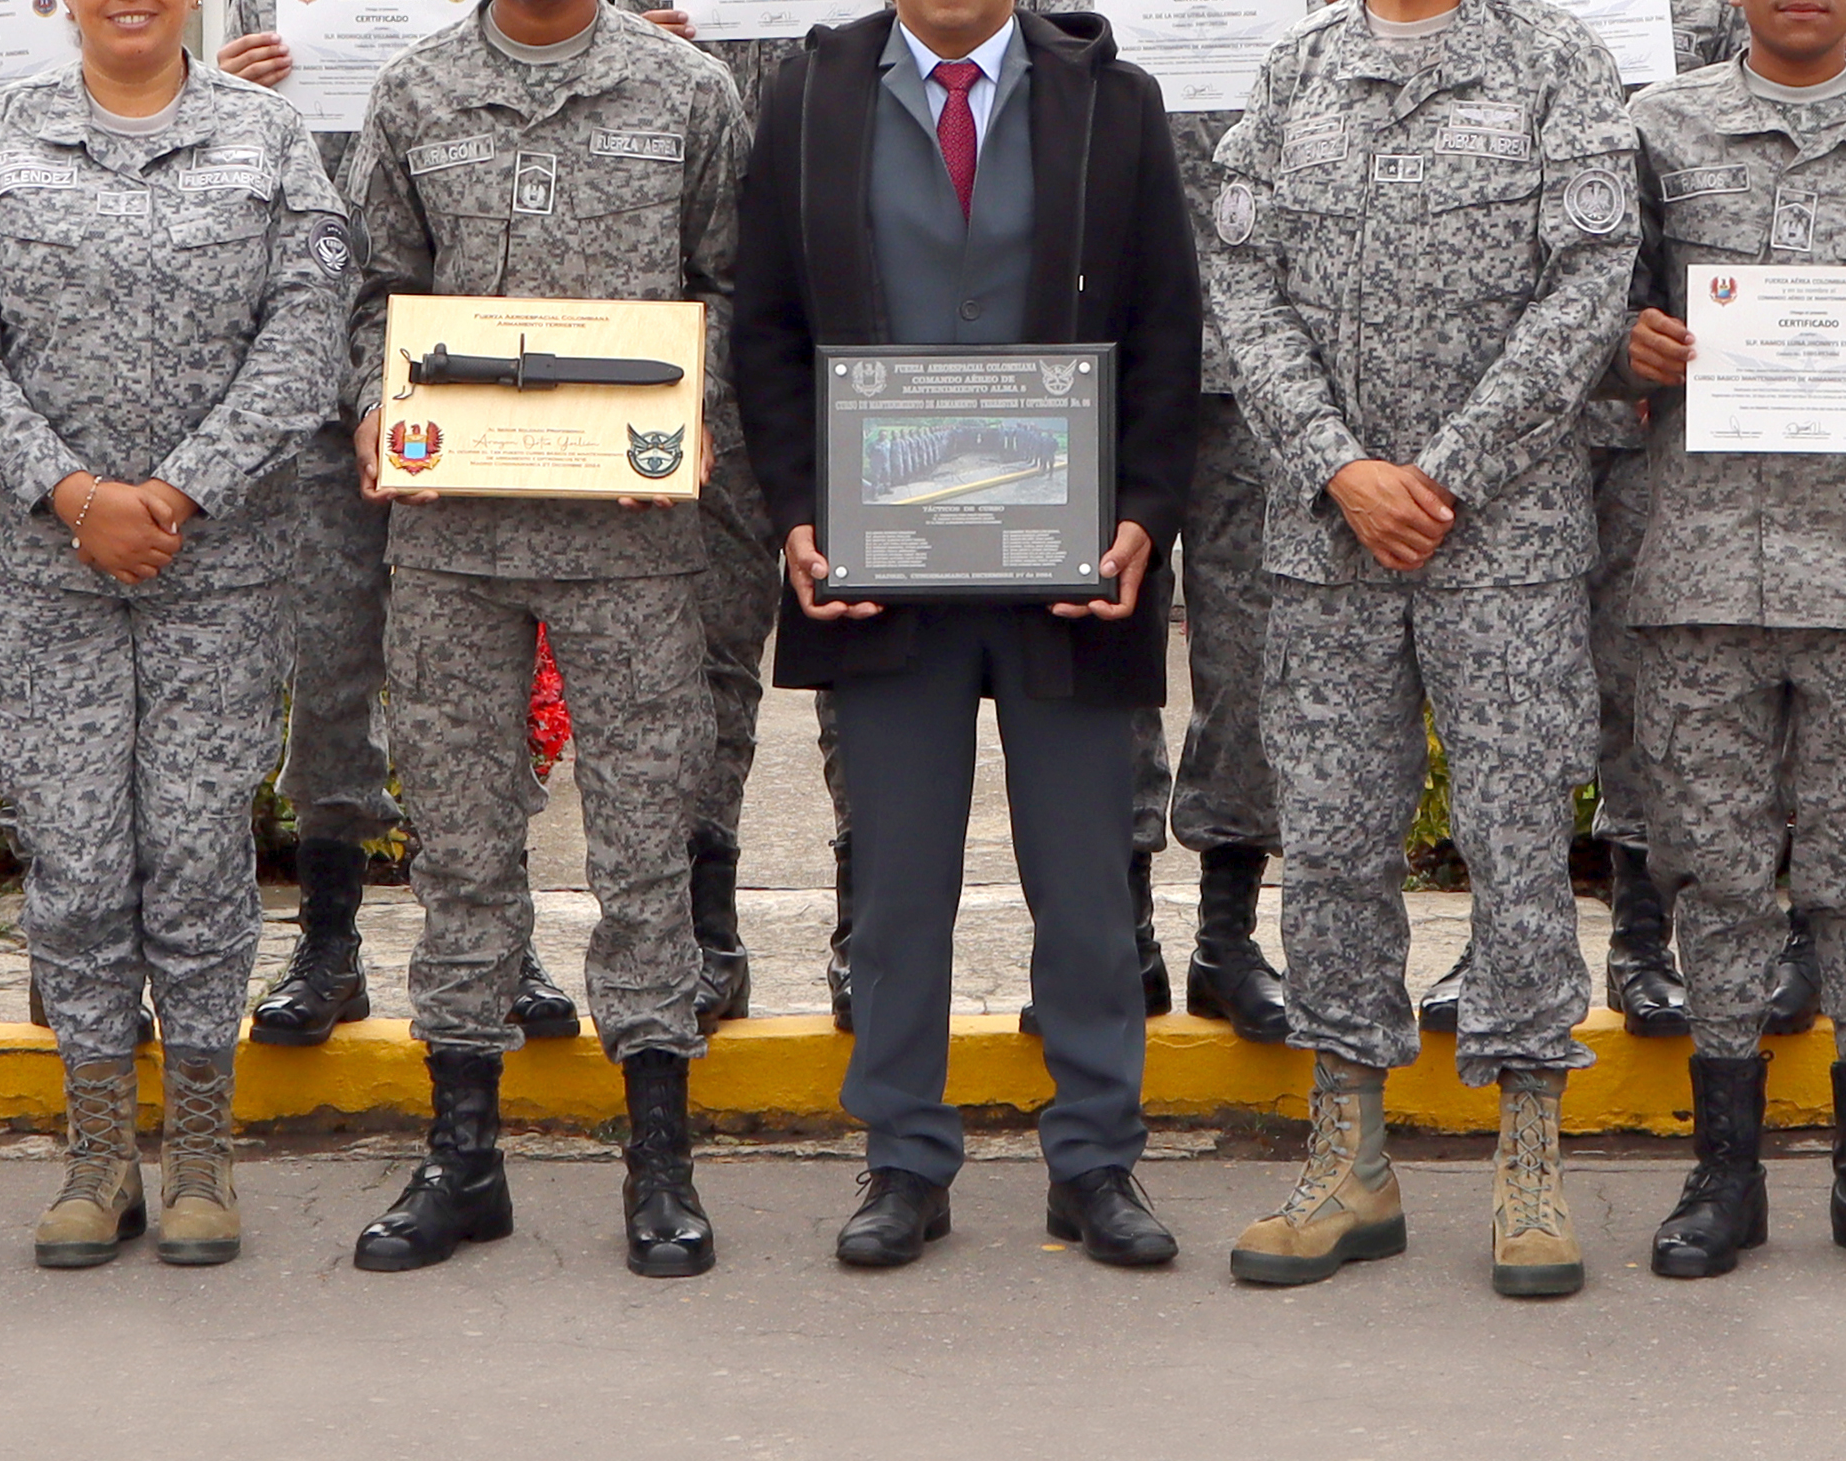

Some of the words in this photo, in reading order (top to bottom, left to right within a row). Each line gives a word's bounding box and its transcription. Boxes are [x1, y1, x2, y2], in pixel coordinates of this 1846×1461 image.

[355, 15, 409, 23] CERTIFICADO
[597, 136, 638, 152] FUERZA
[644, 138, 677, 156] AEREA
[1444, 135, 1486, 150] FUERZA
[1489, 138, 1525, 154] AEREA
[185, 171, 232, 186] FUERZA
[1682, 174, 1725, 189] RAMOS
[1790, 277, 1811, 285] AÉREA
[1778, 319, 1839, 328] CERTIFICADO
[912, 376, 961, 384] COMANDO
[964, 373, 998, 383] AÉREO
[1001, 375, 1015, 383] DE
[990, 384, 1017, 393] ALMA
[858, 401, 867, 410] DE
[925, 400, 934, 409] DE
